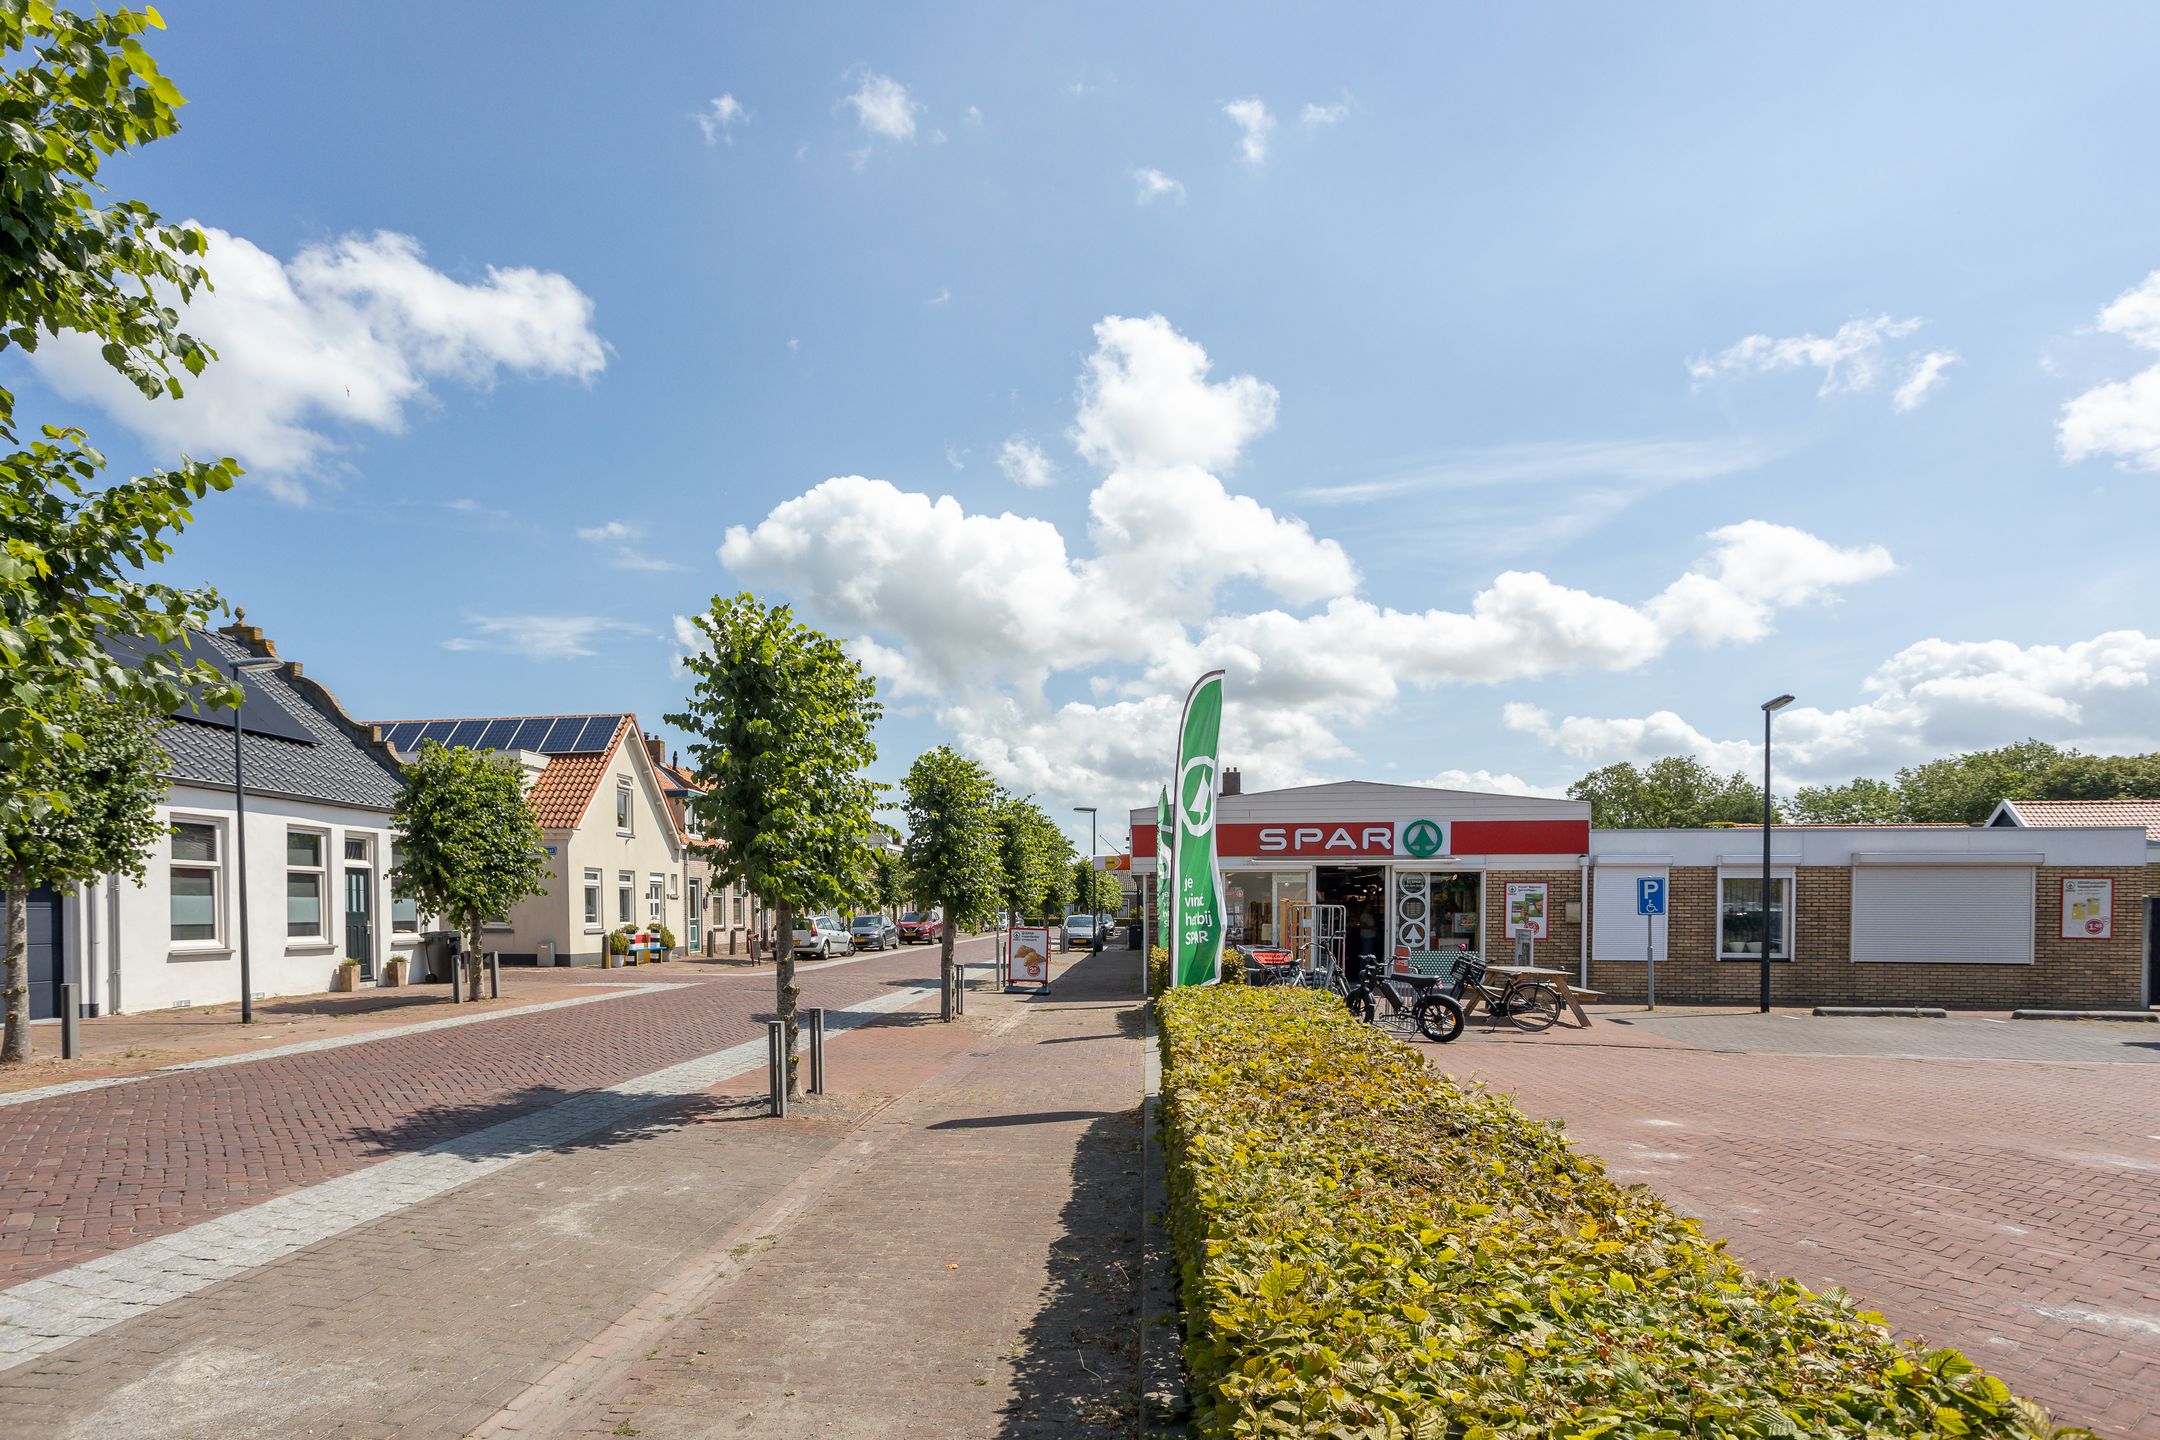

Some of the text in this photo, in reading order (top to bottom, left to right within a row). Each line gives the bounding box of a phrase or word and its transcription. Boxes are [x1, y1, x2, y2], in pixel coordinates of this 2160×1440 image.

[1259, 828, 1392, 850] SPAR
[1184, 874, 1193, 892] je
[1644, 881, 1659, 899] P
[1185, 930, 1209, 945] SPAR
